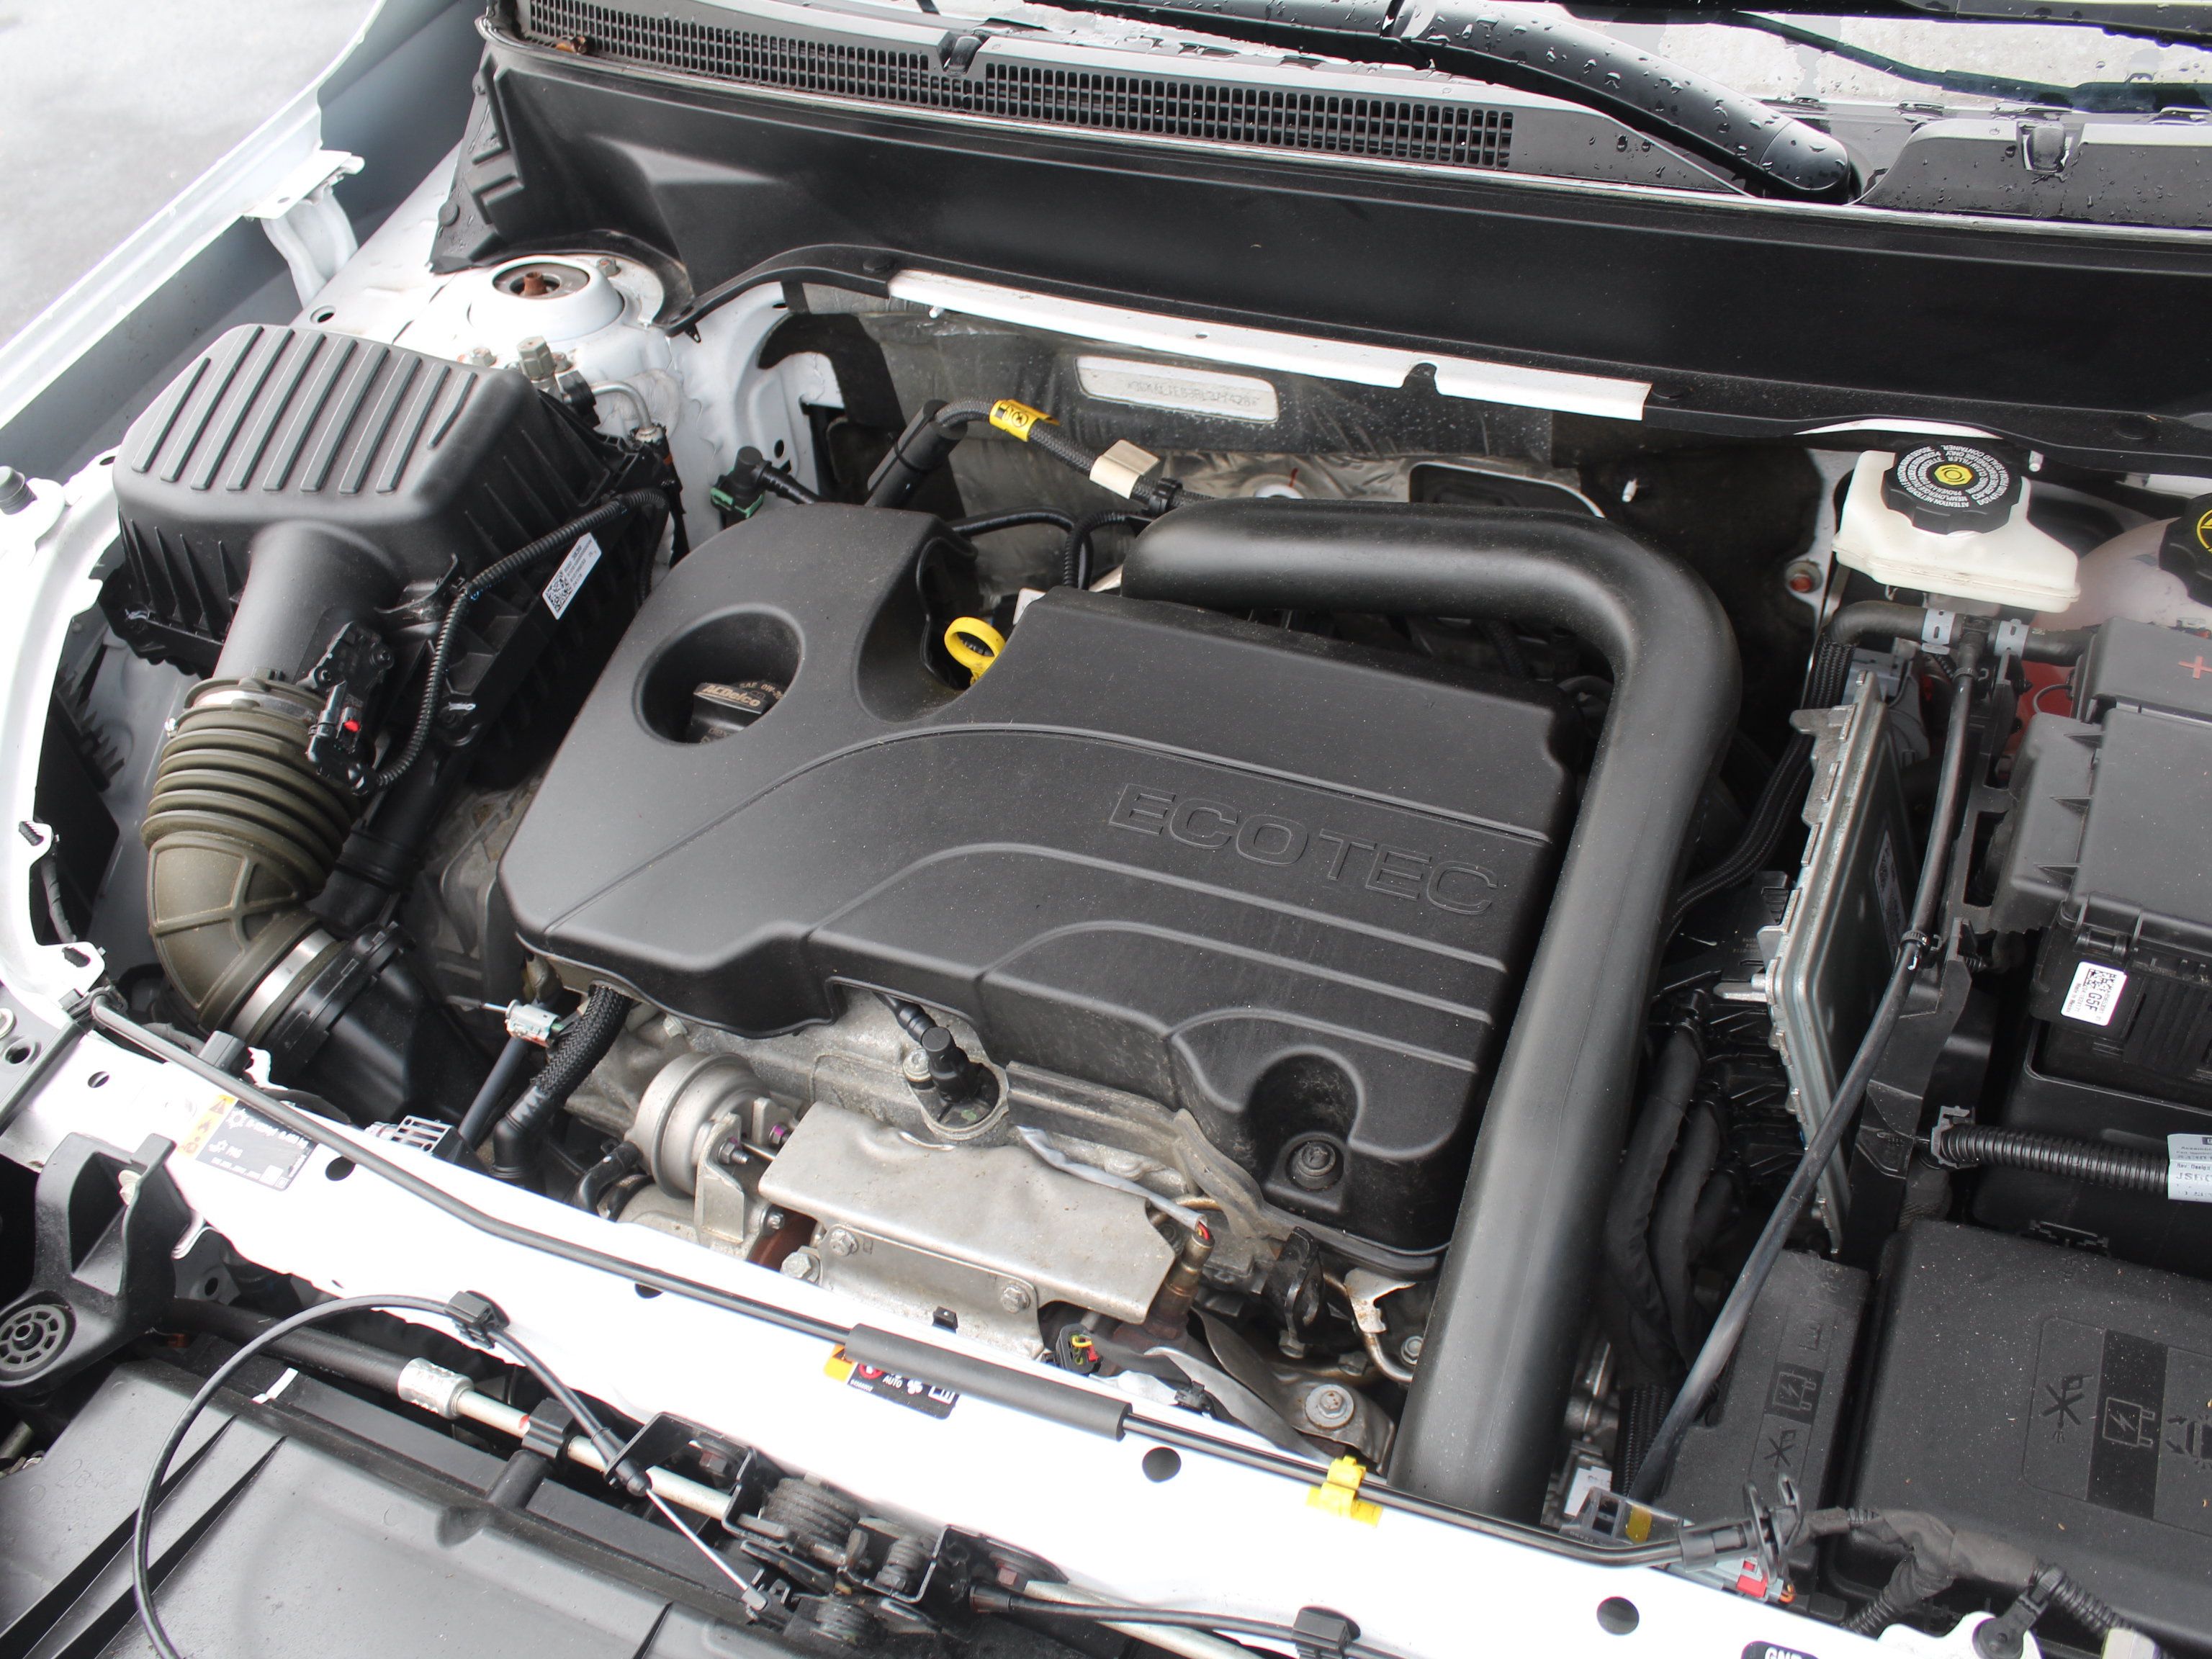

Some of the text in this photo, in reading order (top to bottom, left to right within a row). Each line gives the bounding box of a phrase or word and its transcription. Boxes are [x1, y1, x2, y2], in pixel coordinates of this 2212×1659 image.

[1985, 453, 2008, 469] SEALED
[1998, 474, 2010, 486] FROM
[1991, 485, 2006, 496] FLUID
[702, 685, 760, 707] ACDelco
[1108, 783, 1498, 916] ECOTEC
[2085, 994, 2102, 1012] G5F
[882, 1375, 903, 1388] AUTO
